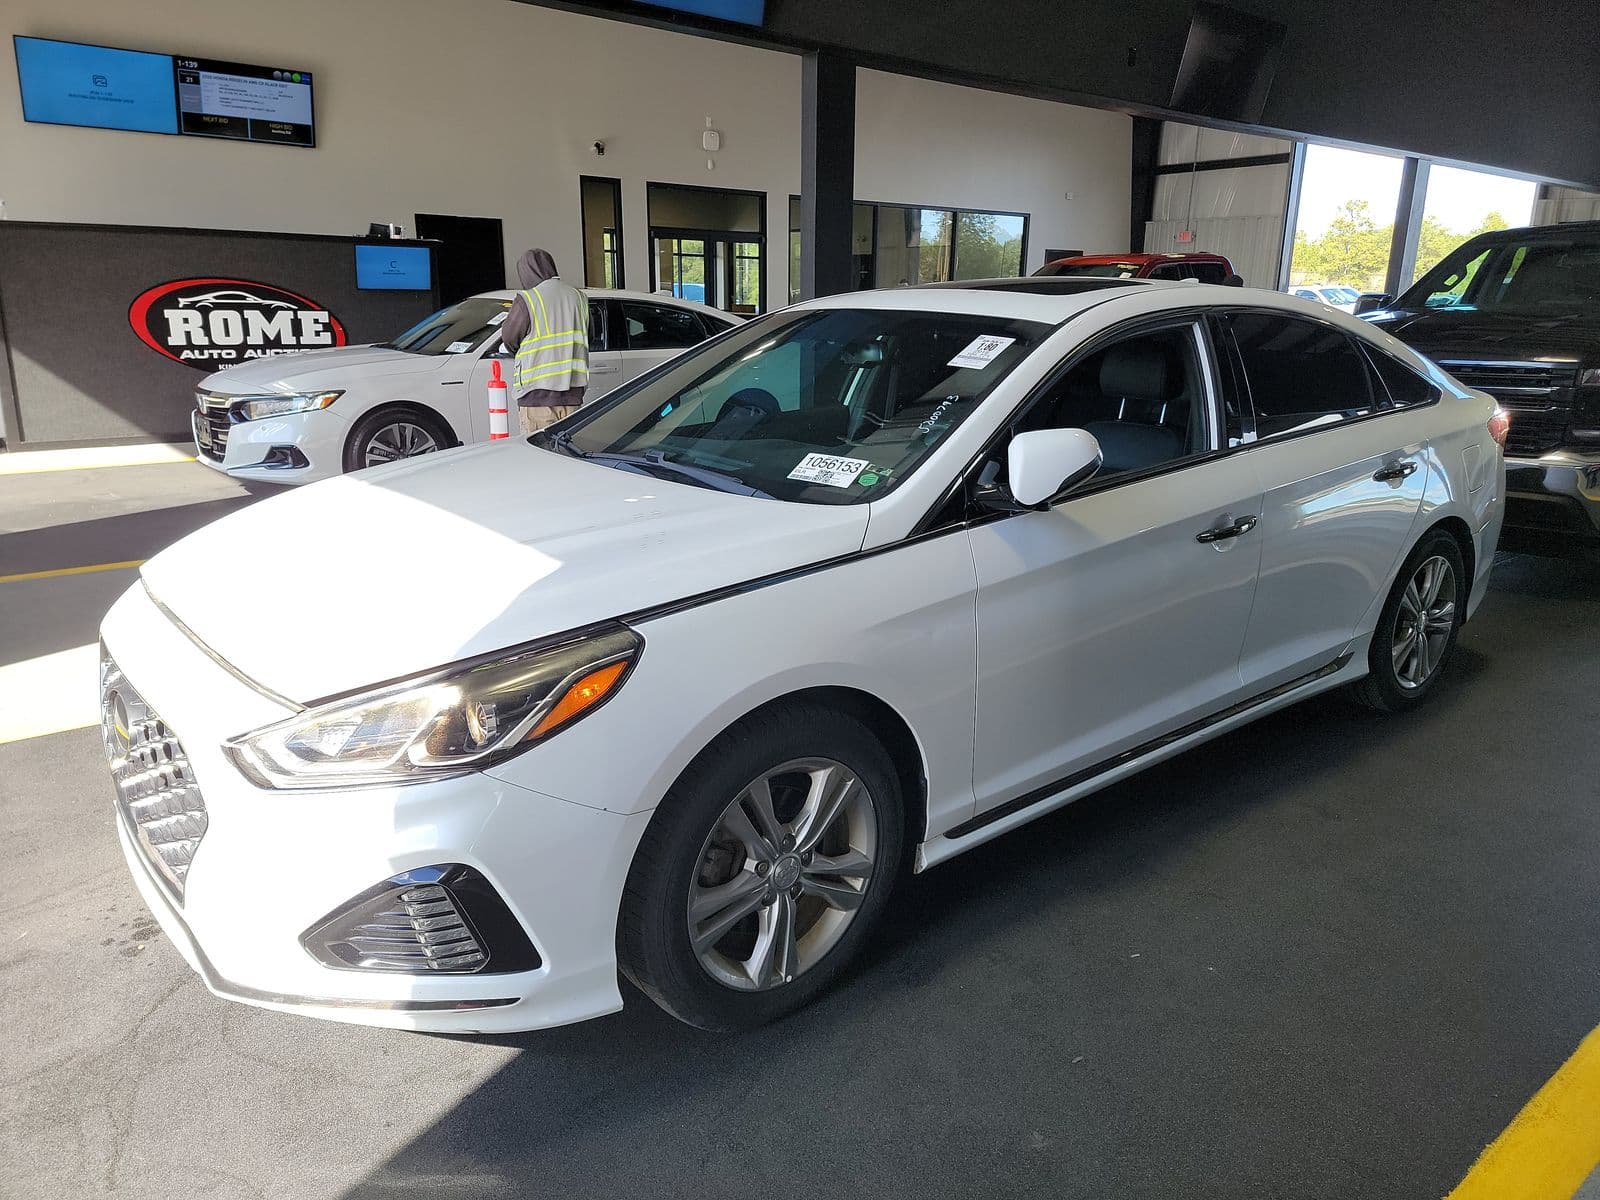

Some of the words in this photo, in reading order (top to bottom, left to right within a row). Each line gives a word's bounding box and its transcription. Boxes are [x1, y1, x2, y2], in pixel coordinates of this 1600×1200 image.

[177, 60, 198, 68] 1-139
[163, 309, 332, 346] ROME
[180, 349, 240, 360] AUTO
[805, 456, 862, 474] 1056153
